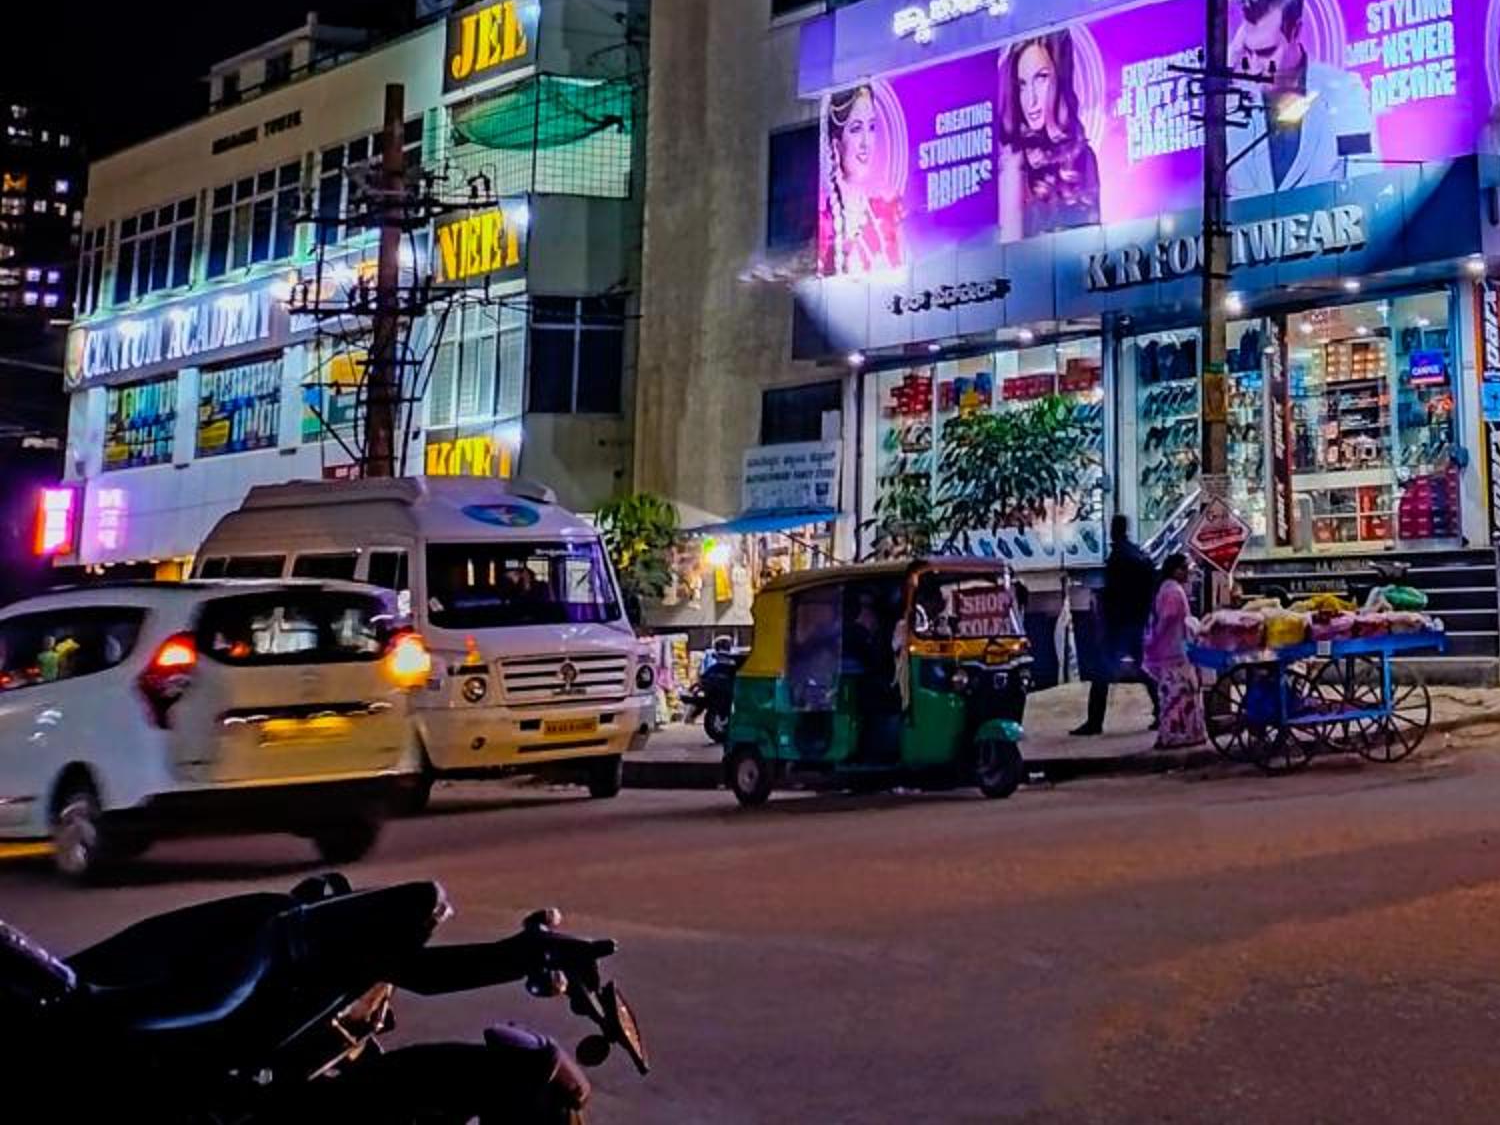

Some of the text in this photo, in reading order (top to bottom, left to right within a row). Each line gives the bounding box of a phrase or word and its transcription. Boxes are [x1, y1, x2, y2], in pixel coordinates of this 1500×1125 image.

[1382, 20, 1454, 70] NEVER
[935, 100, 993, 136] CREATING
[919, 126, 993, 170] STUNNING
[927, 159, 993, 213] BRIDES
[1085, 204, 1367, 290] K R FOTWEAR
[83, 319, 162, 378] CENTUM
[166, 285, 272, 360] ACADEMY
[959, 593, 1011, 613] SHOP
